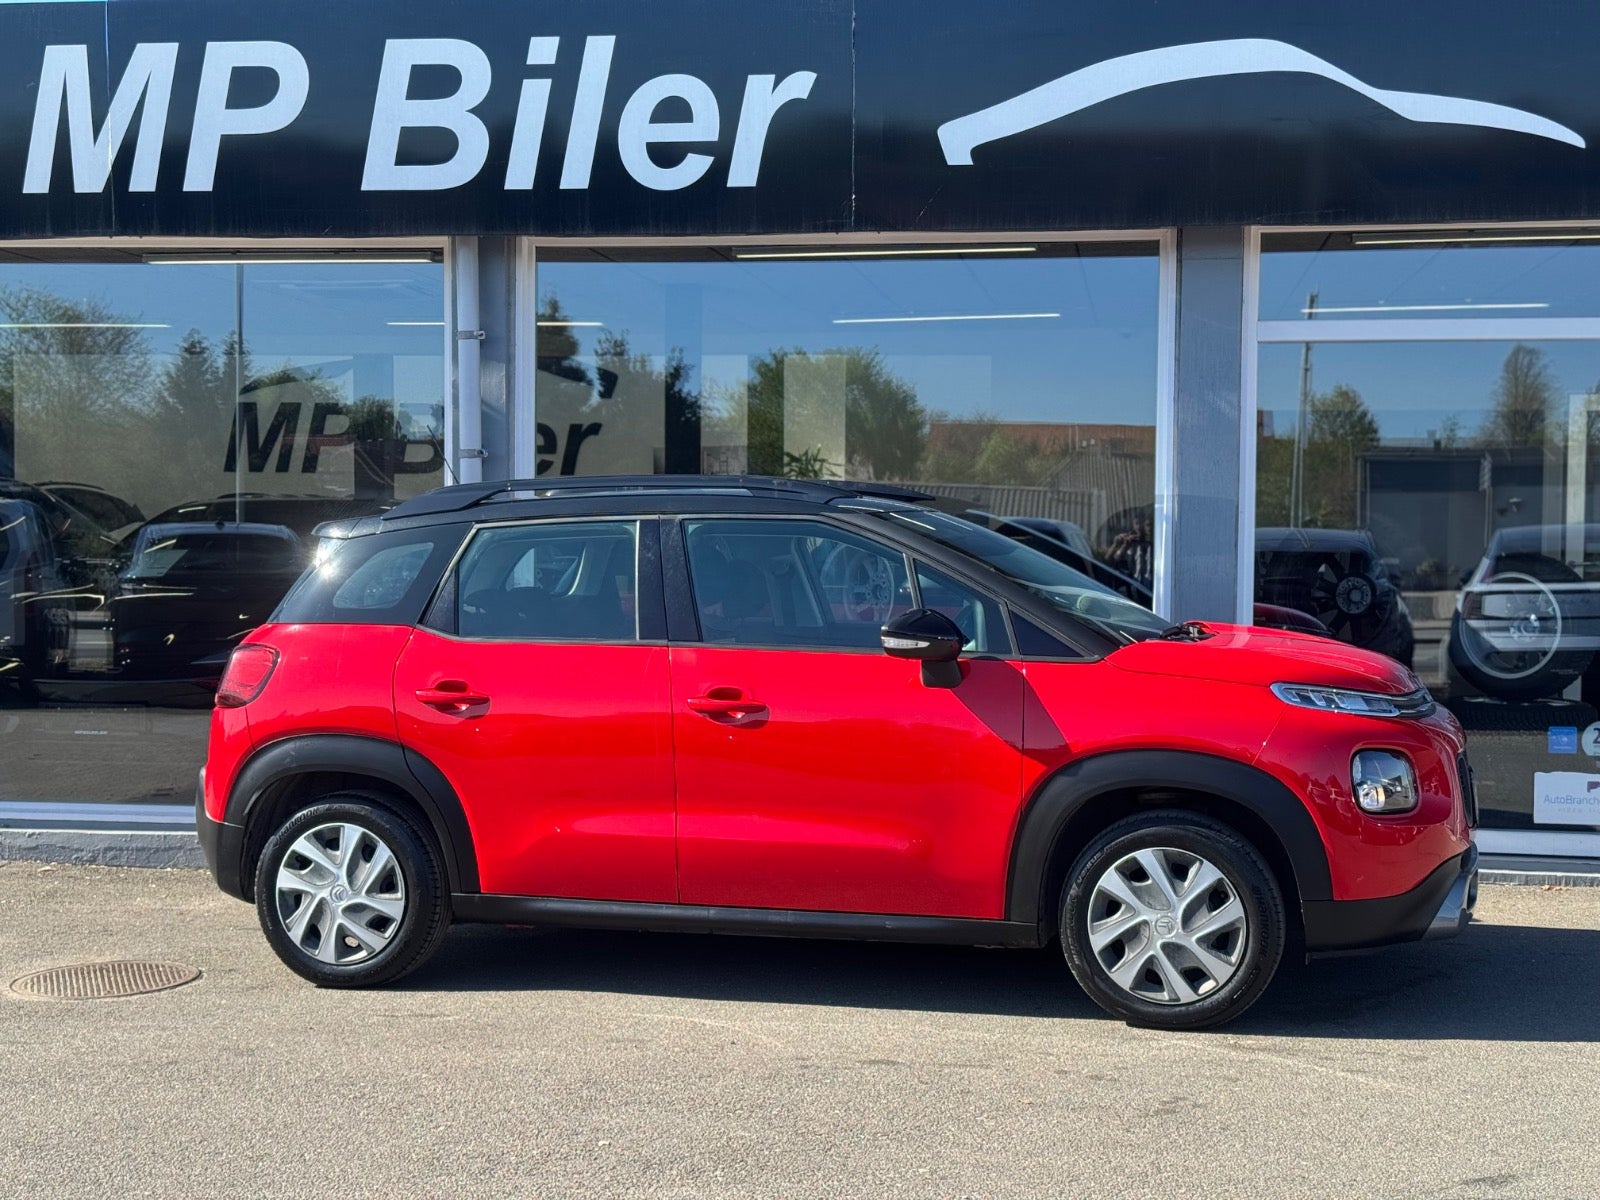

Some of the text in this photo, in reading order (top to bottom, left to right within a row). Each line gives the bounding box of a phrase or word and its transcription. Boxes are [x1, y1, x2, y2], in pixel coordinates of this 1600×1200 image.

[22, 36, 817, 193] MP Biler
[224, 402, 358, 473] MP
